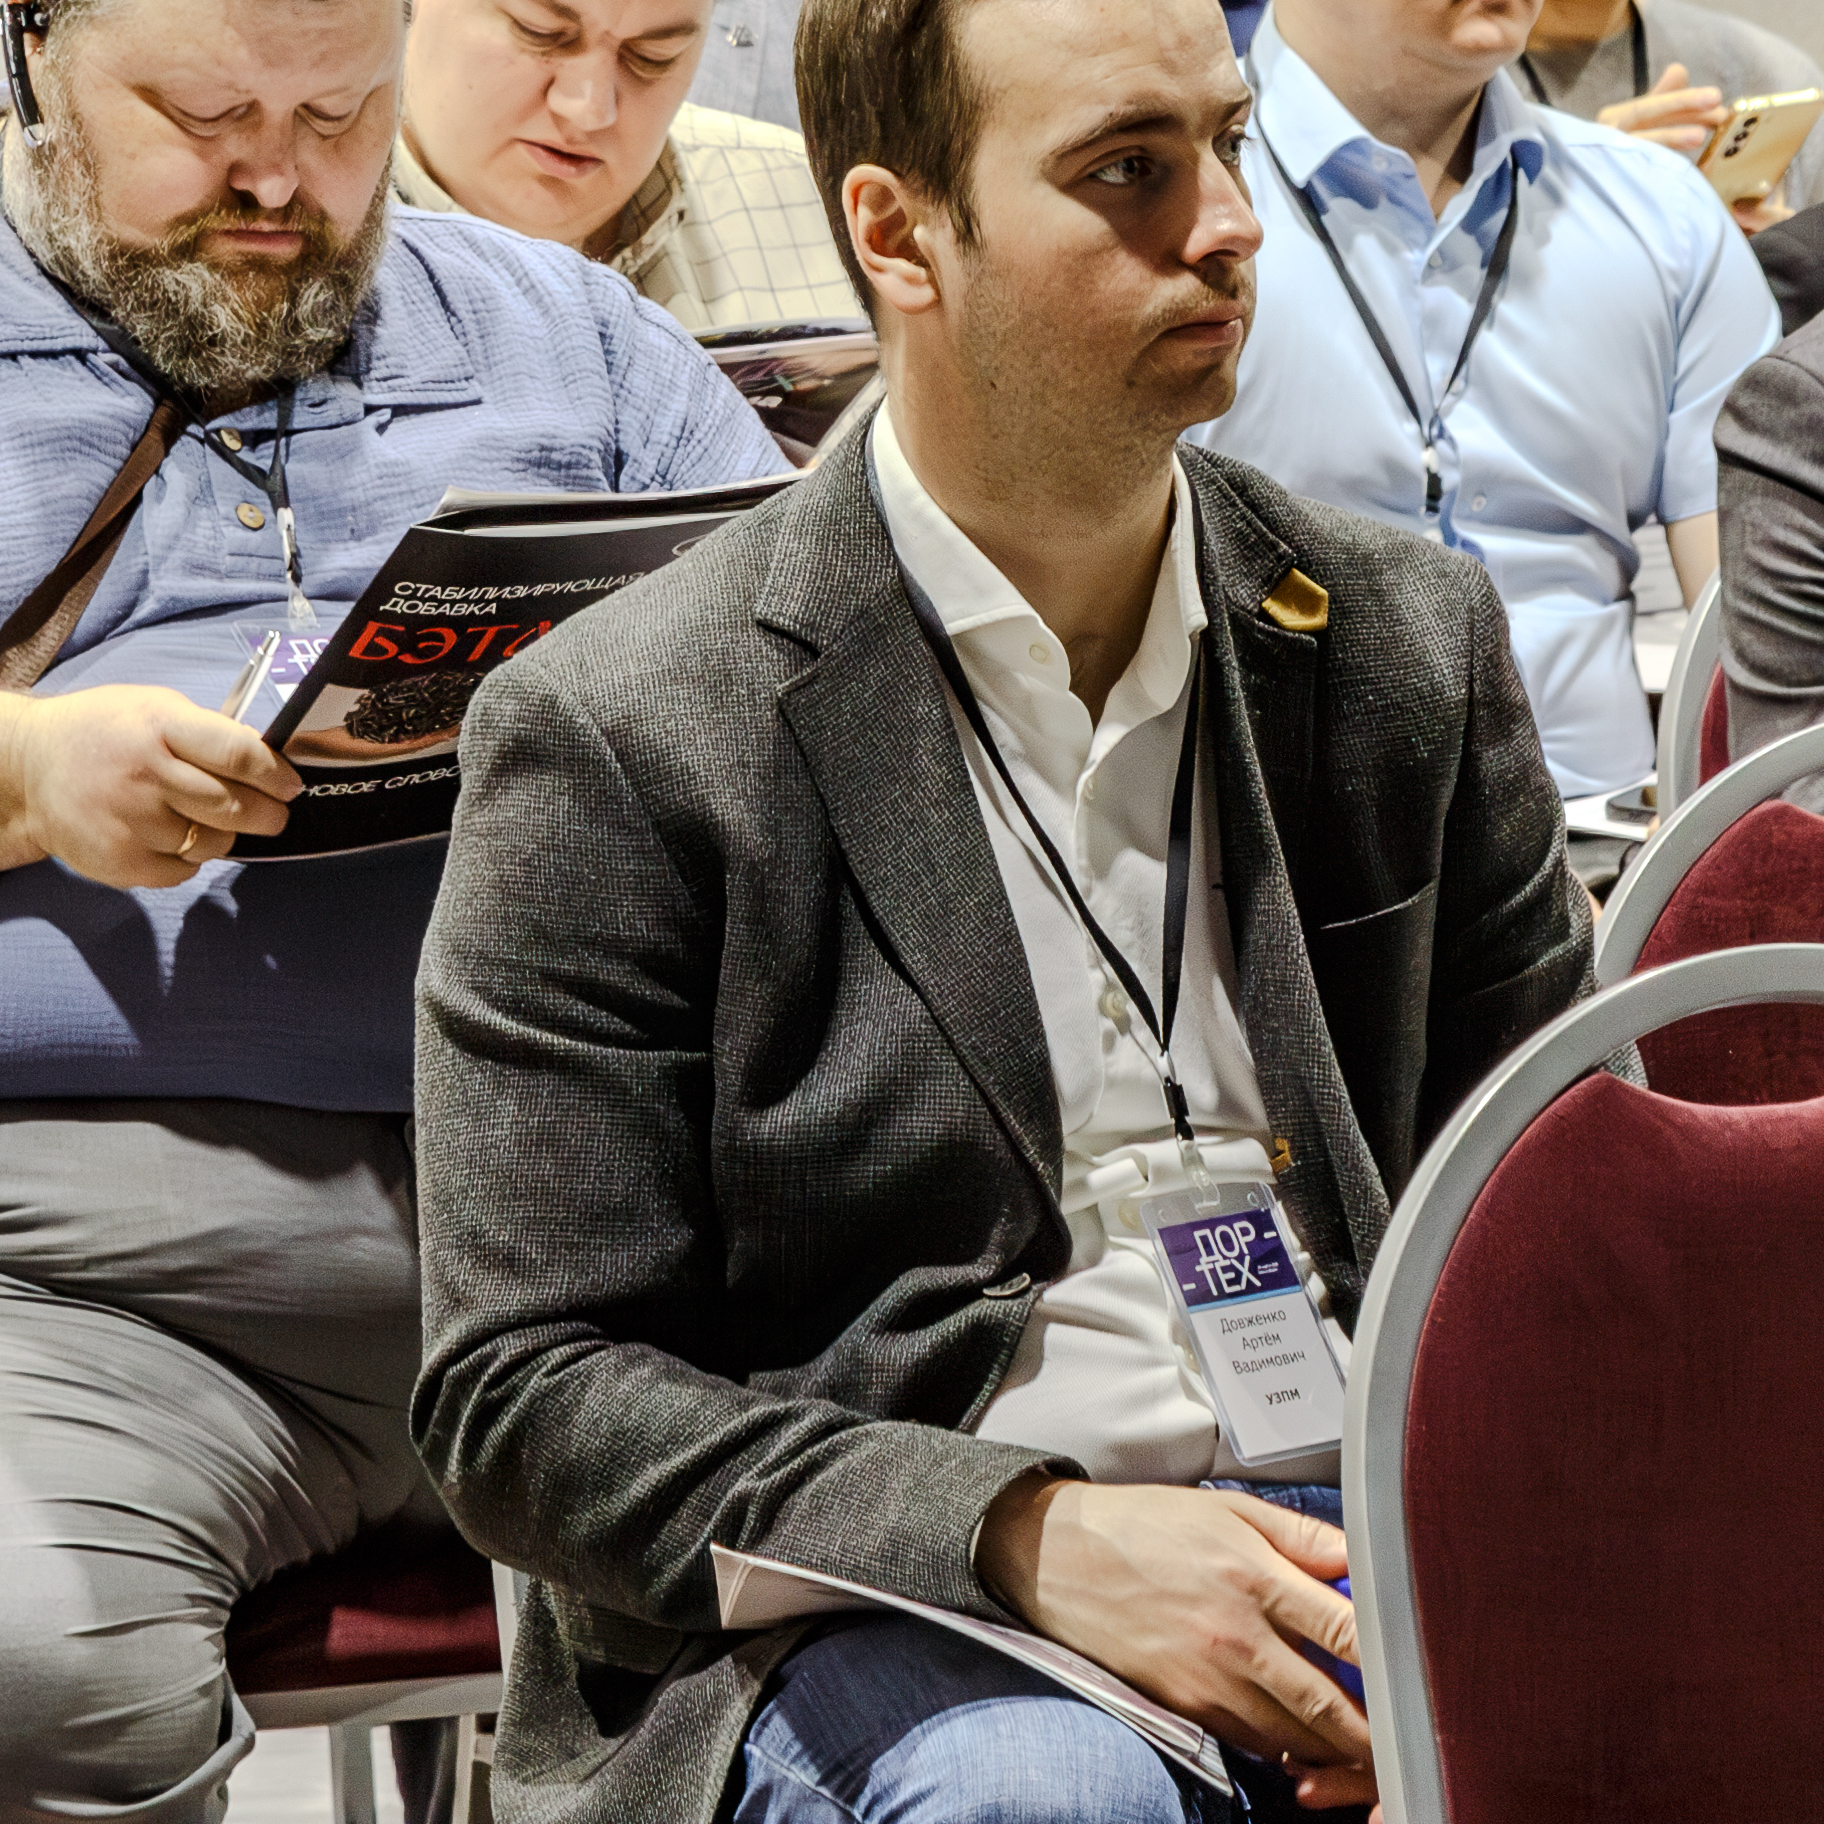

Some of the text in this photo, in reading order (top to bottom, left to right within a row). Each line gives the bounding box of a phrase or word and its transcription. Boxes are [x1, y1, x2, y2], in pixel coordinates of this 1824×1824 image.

[379, 598, 497, 616] ДОБАВКА
[303, 765, 461, 797] НОВОЕ СЛОВО
[1220, 1309, 1287, 1335] Довженко
[1241, 1331, 1282, 1352] Артём
[1232, 1349, 1307, 1375] Вадимович
[1265, 1388, 1301, 1406] УЗПМ
